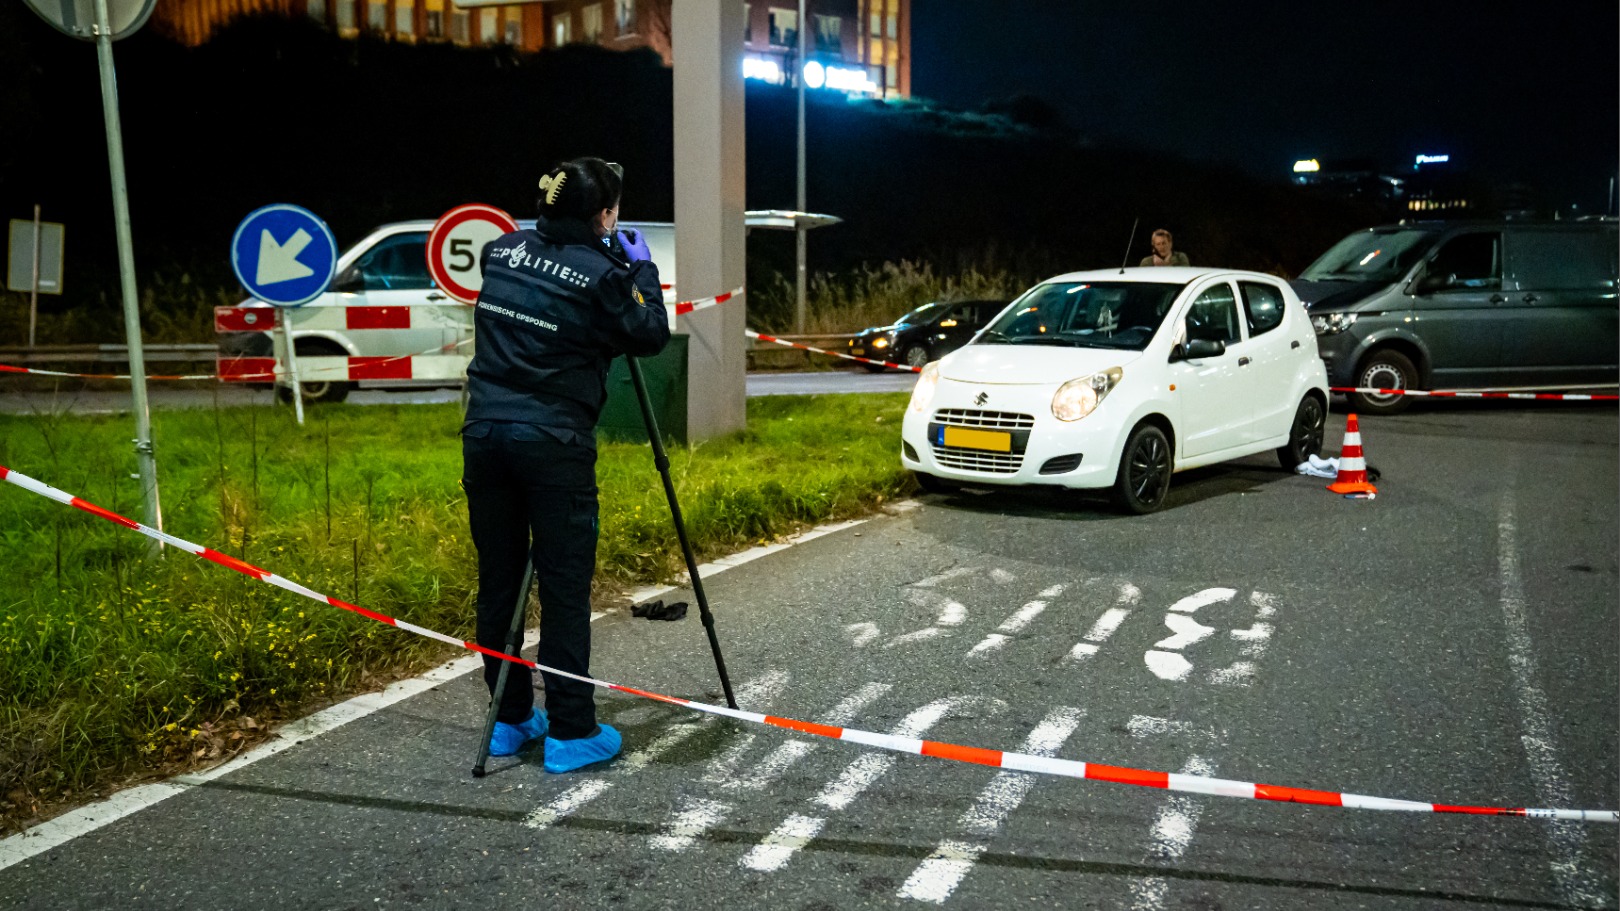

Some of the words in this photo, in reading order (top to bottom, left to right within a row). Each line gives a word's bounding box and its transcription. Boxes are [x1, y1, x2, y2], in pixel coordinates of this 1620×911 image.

[449, 239, 475, 272] 5
[500, 241, 571, 280] POLITIE
[478, 302, 515, 318] FORENSISCHE
[516, 313, 558, 331] OPSPORING
